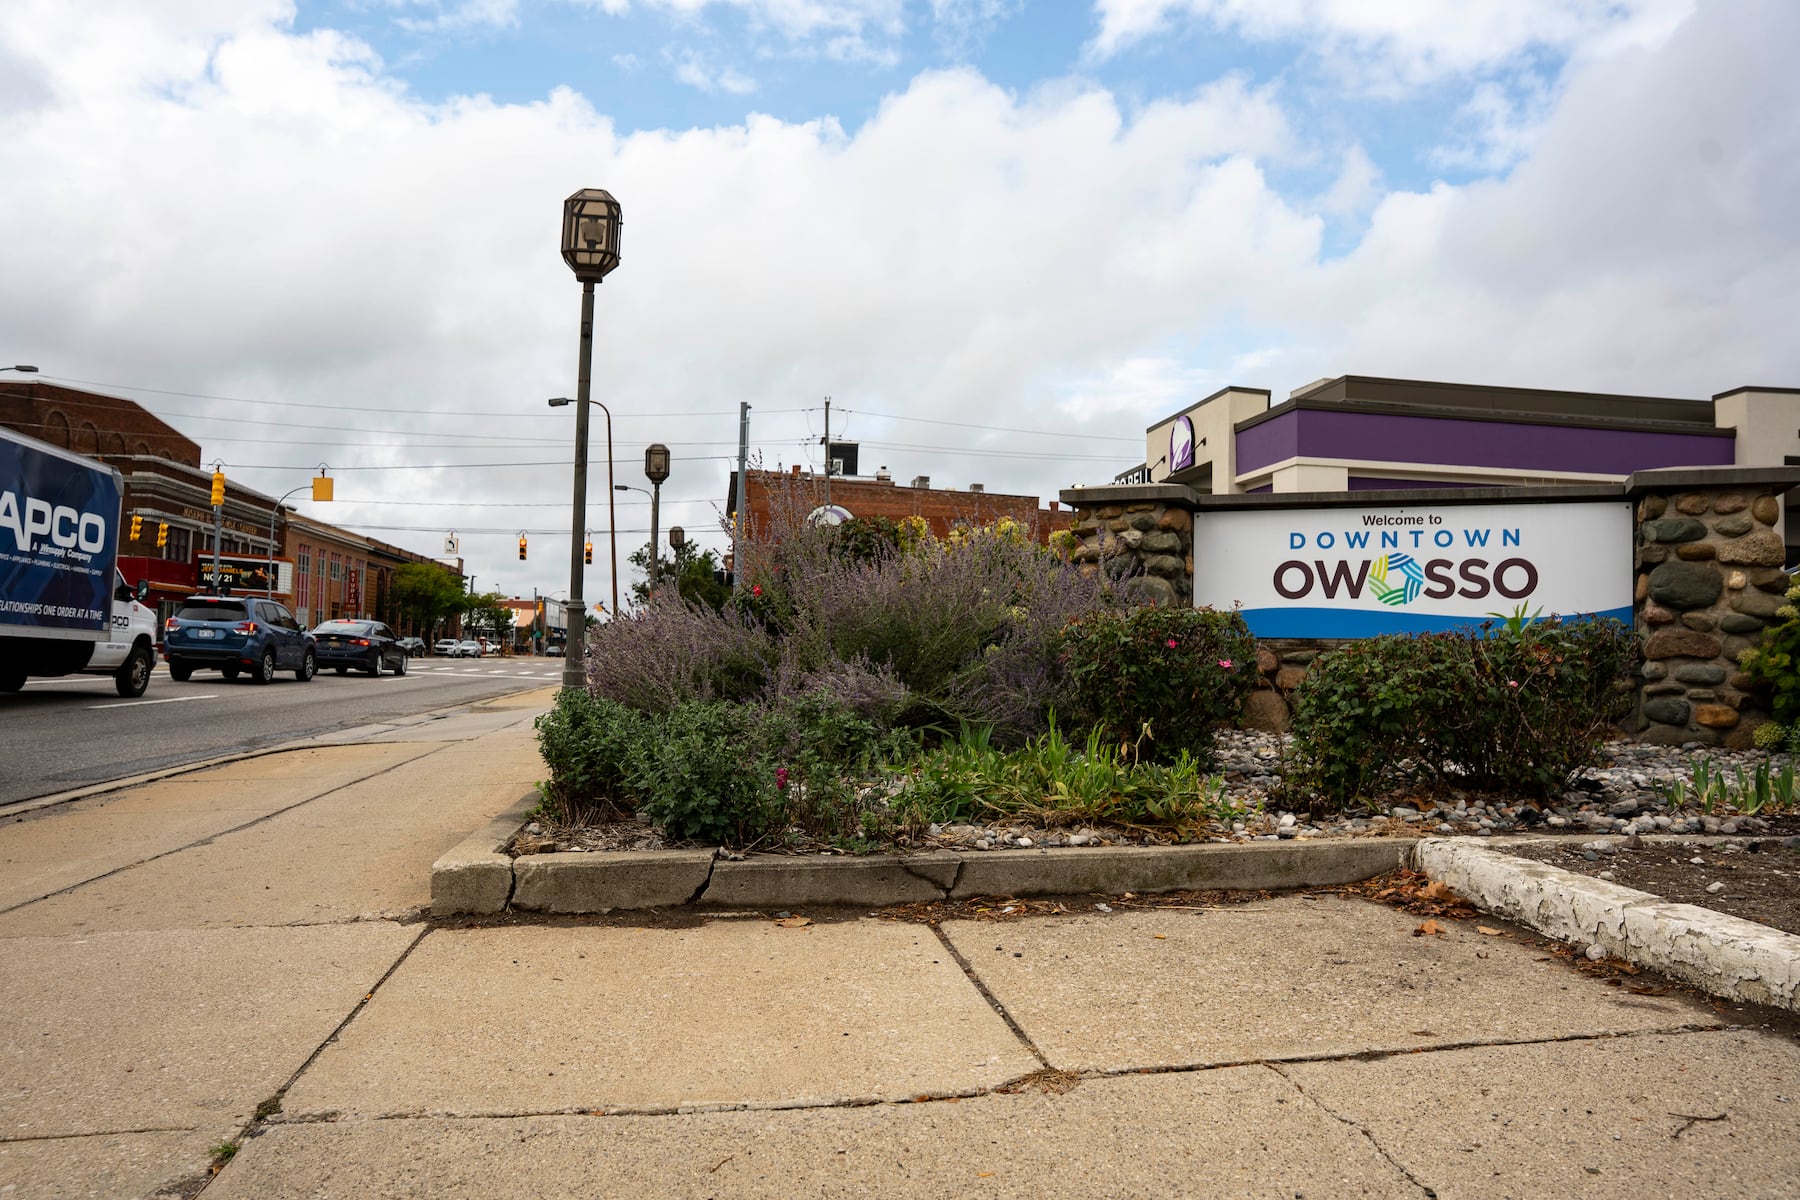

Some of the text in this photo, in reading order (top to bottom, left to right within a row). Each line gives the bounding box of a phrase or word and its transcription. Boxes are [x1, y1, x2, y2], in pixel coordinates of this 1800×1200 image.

[0, 490, 105, 554] APCO
[1362, 514, 1442, 526] Welcome to
[1290, 528, 1520, 549] DOWNTOWN
[32, 541, 37, 551] A
[67, 549, 92, 563] Company
[224, 574, 233, 583] 21
[1273, 552, 1538, 606] OWOSSO
[43, 604, 56, 616] ONE
[57, 606, 77, 619] ORDER
[77, 608, 85, 619] AT
[84, 609, 89, 619] A
[89, 609, 104, 620] TIME
